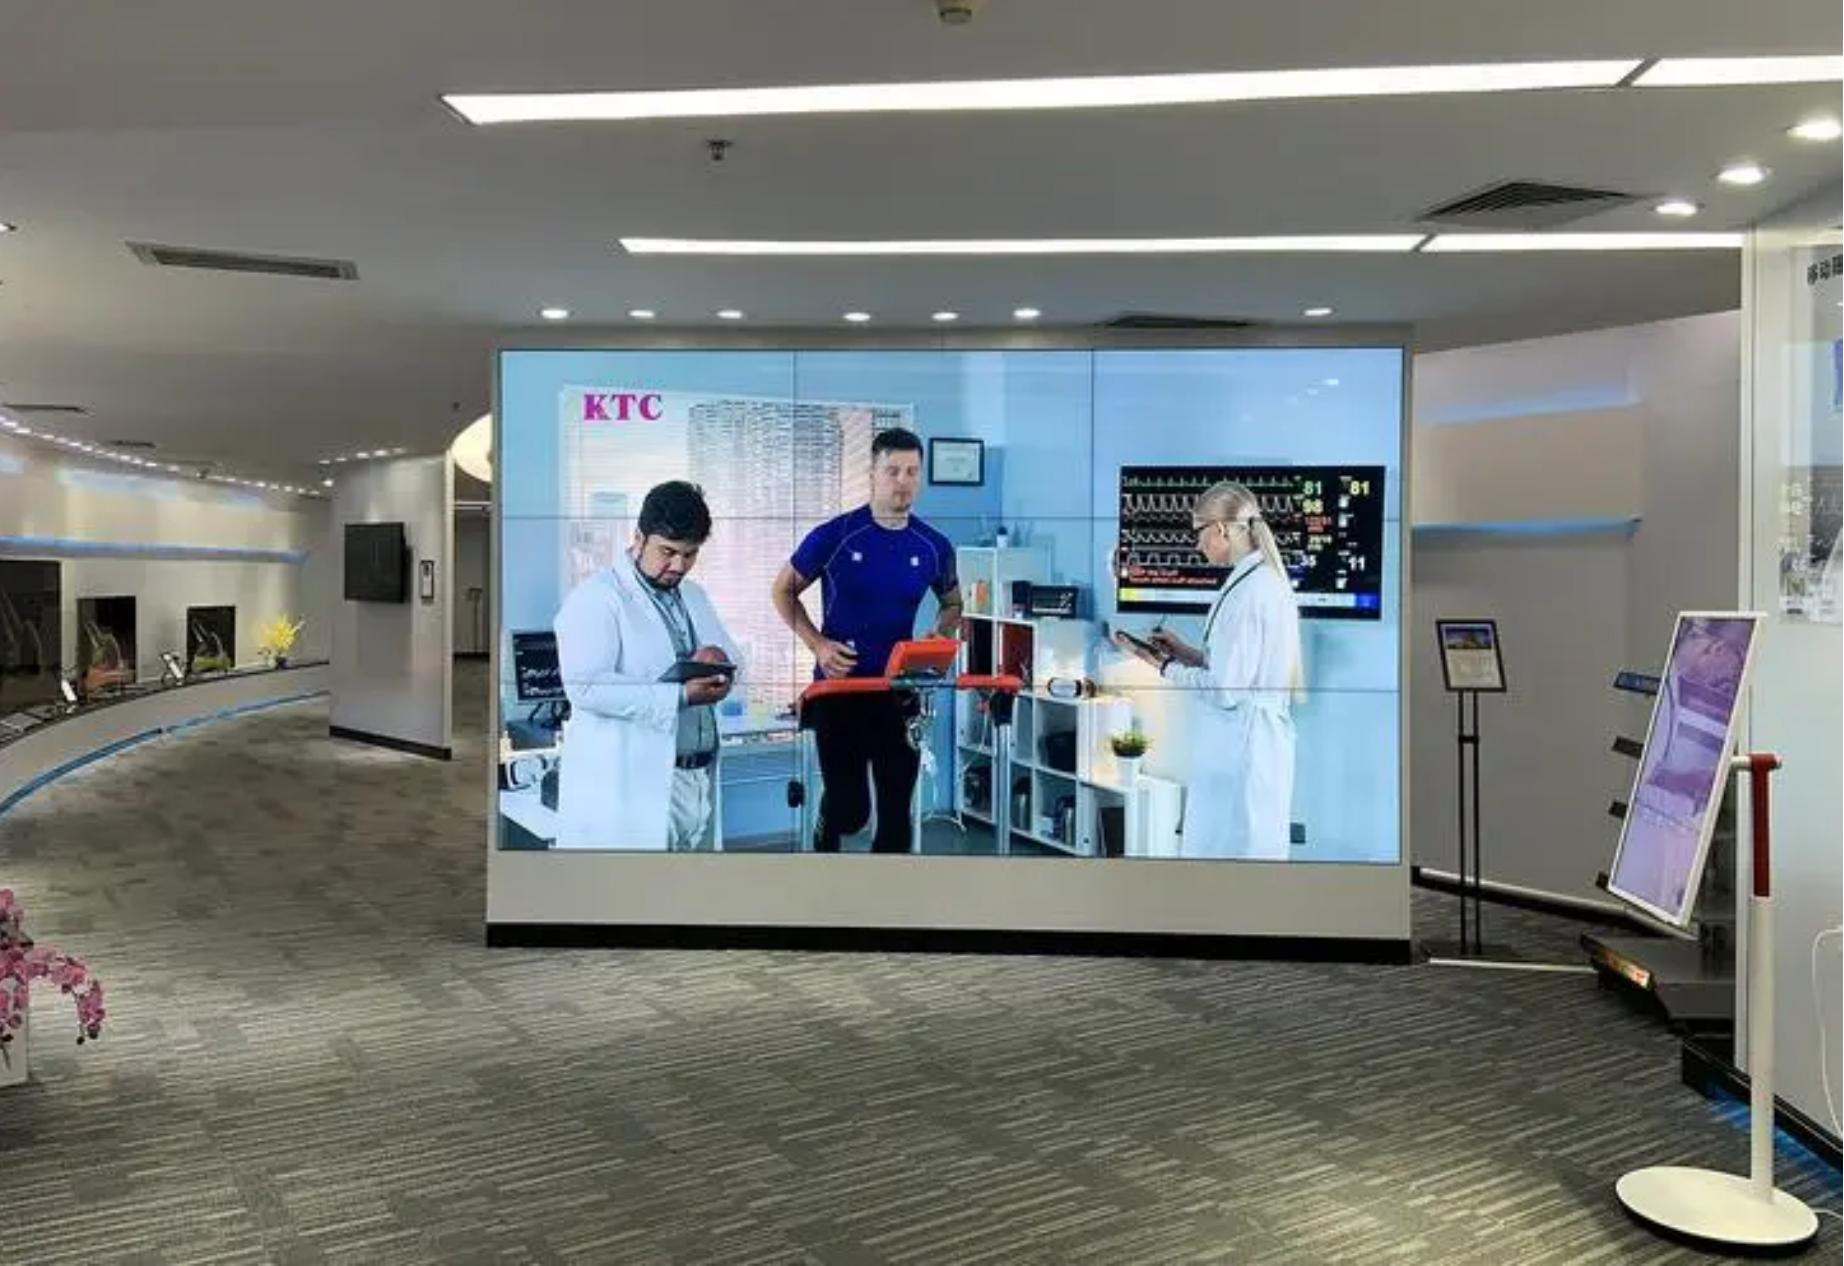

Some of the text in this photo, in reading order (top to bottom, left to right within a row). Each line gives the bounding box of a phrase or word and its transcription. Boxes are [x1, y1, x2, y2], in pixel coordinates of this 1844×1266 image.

[584, 394, 663, 421] KTC
[1303, 480, 1322, 495] 81
[1350, 480, 1369, 496] 81
